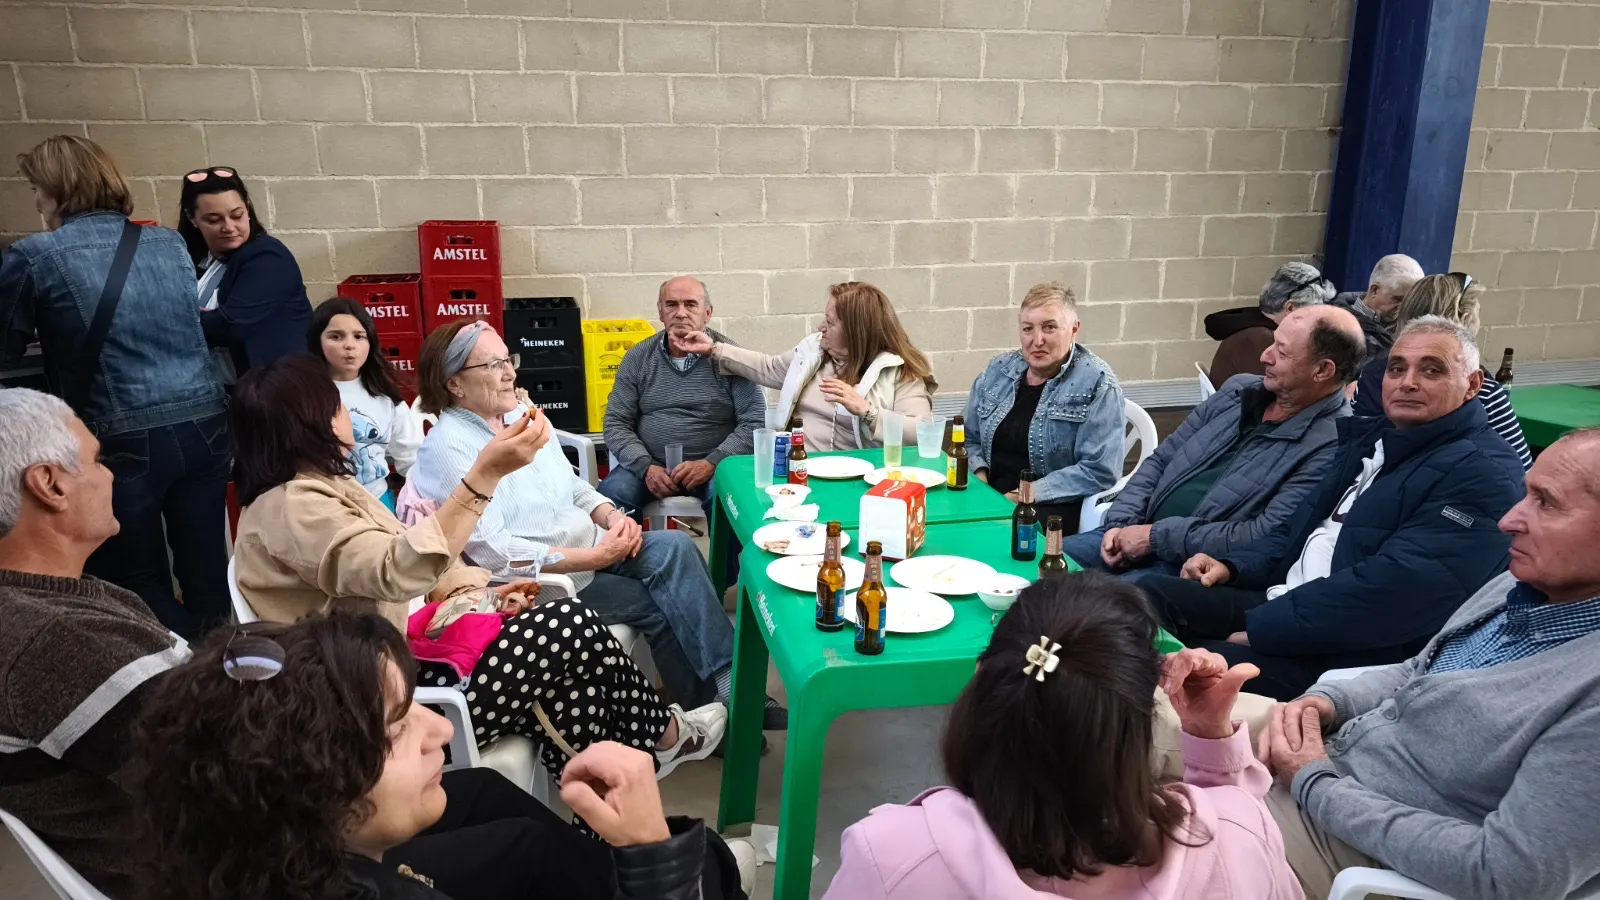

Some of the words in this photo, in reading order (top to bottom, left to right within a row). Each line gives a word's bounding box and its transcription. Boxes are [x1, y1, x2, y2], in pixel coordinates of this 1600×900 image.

[433, 247, 488, 260] AMSTEL
[364, 305, 410, 318] MSTEL
[436, 303, 491, 316] AMSTEL
[390, 360, 415, 371] TEL
[534, 402, 569, 410] EINEKEN
